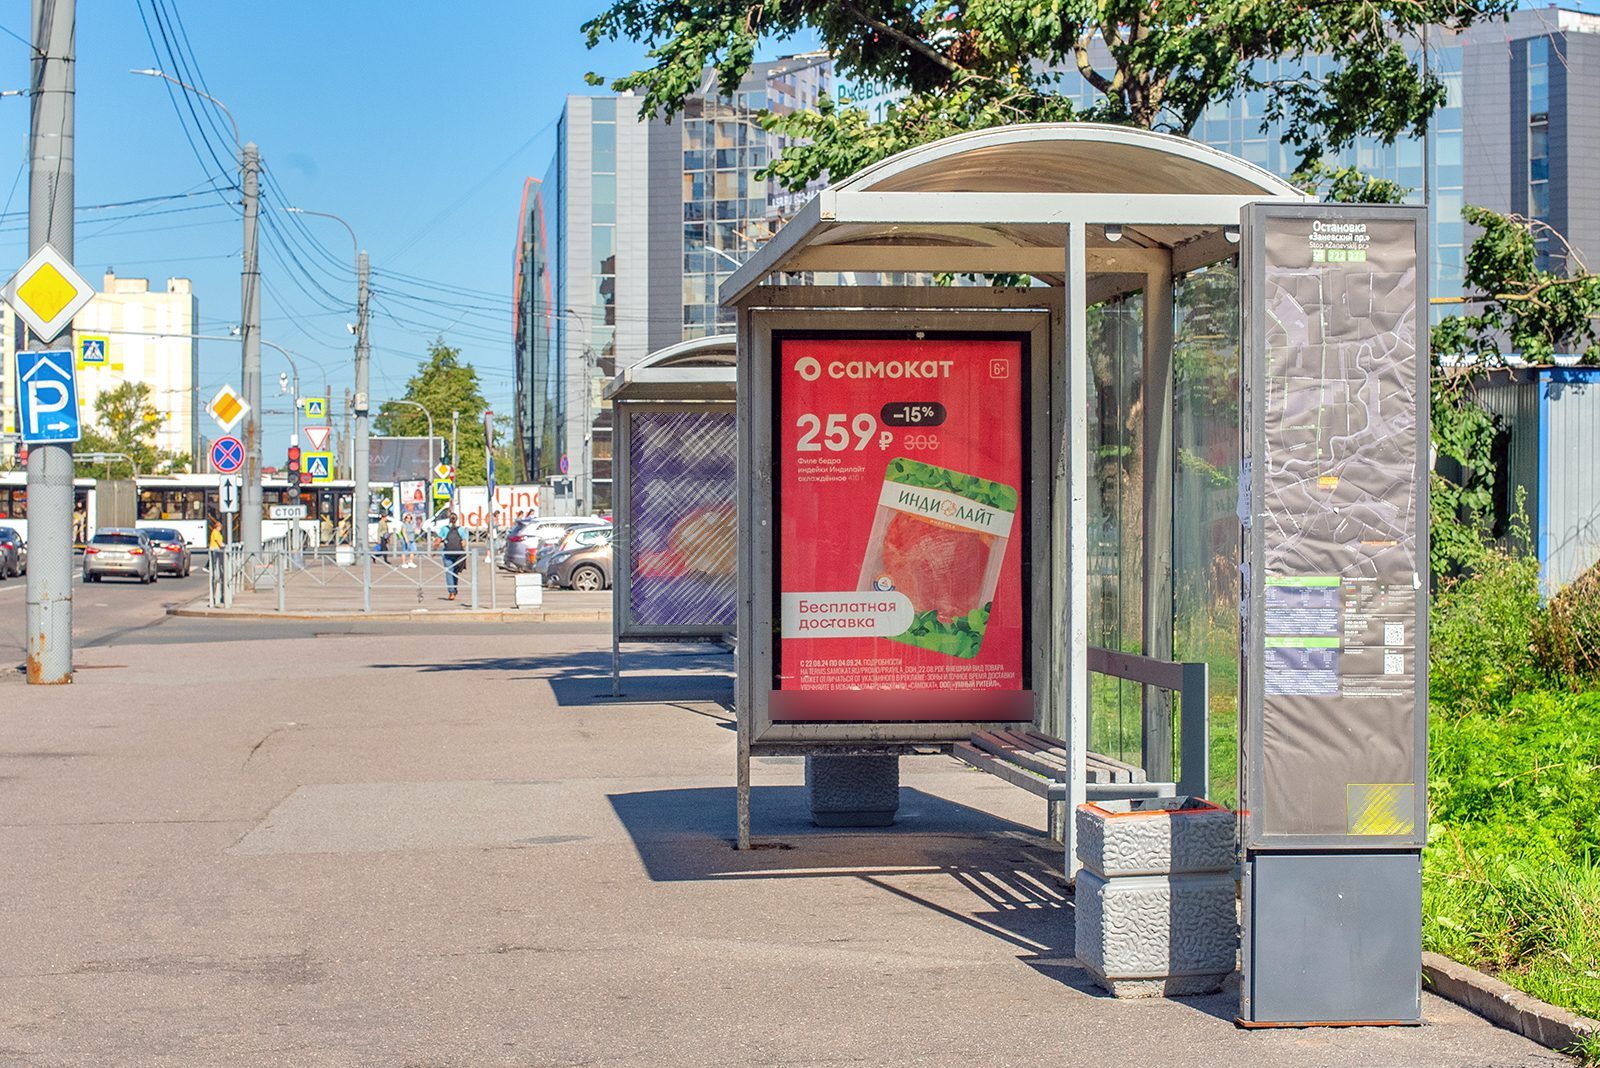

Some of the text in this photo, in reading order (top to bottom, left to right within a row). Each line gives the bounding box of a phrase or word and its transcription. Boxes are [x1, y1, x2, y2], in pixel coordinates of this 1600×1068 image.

[1313, 220, 1366, 232] Остановка
[828, 361, 954, 379] самокат
[993, 362, 1006, 376] 6+
[904, 434, 940, 450] 308
[797, 457, 818, 465] Филе
[797, 465, 866, 474] индейки Индилайт
[275, 508, 301, 516] СТОП
[799, 600, 896, 613] Бесплатная
[799, 618, 875, 631] доставка
